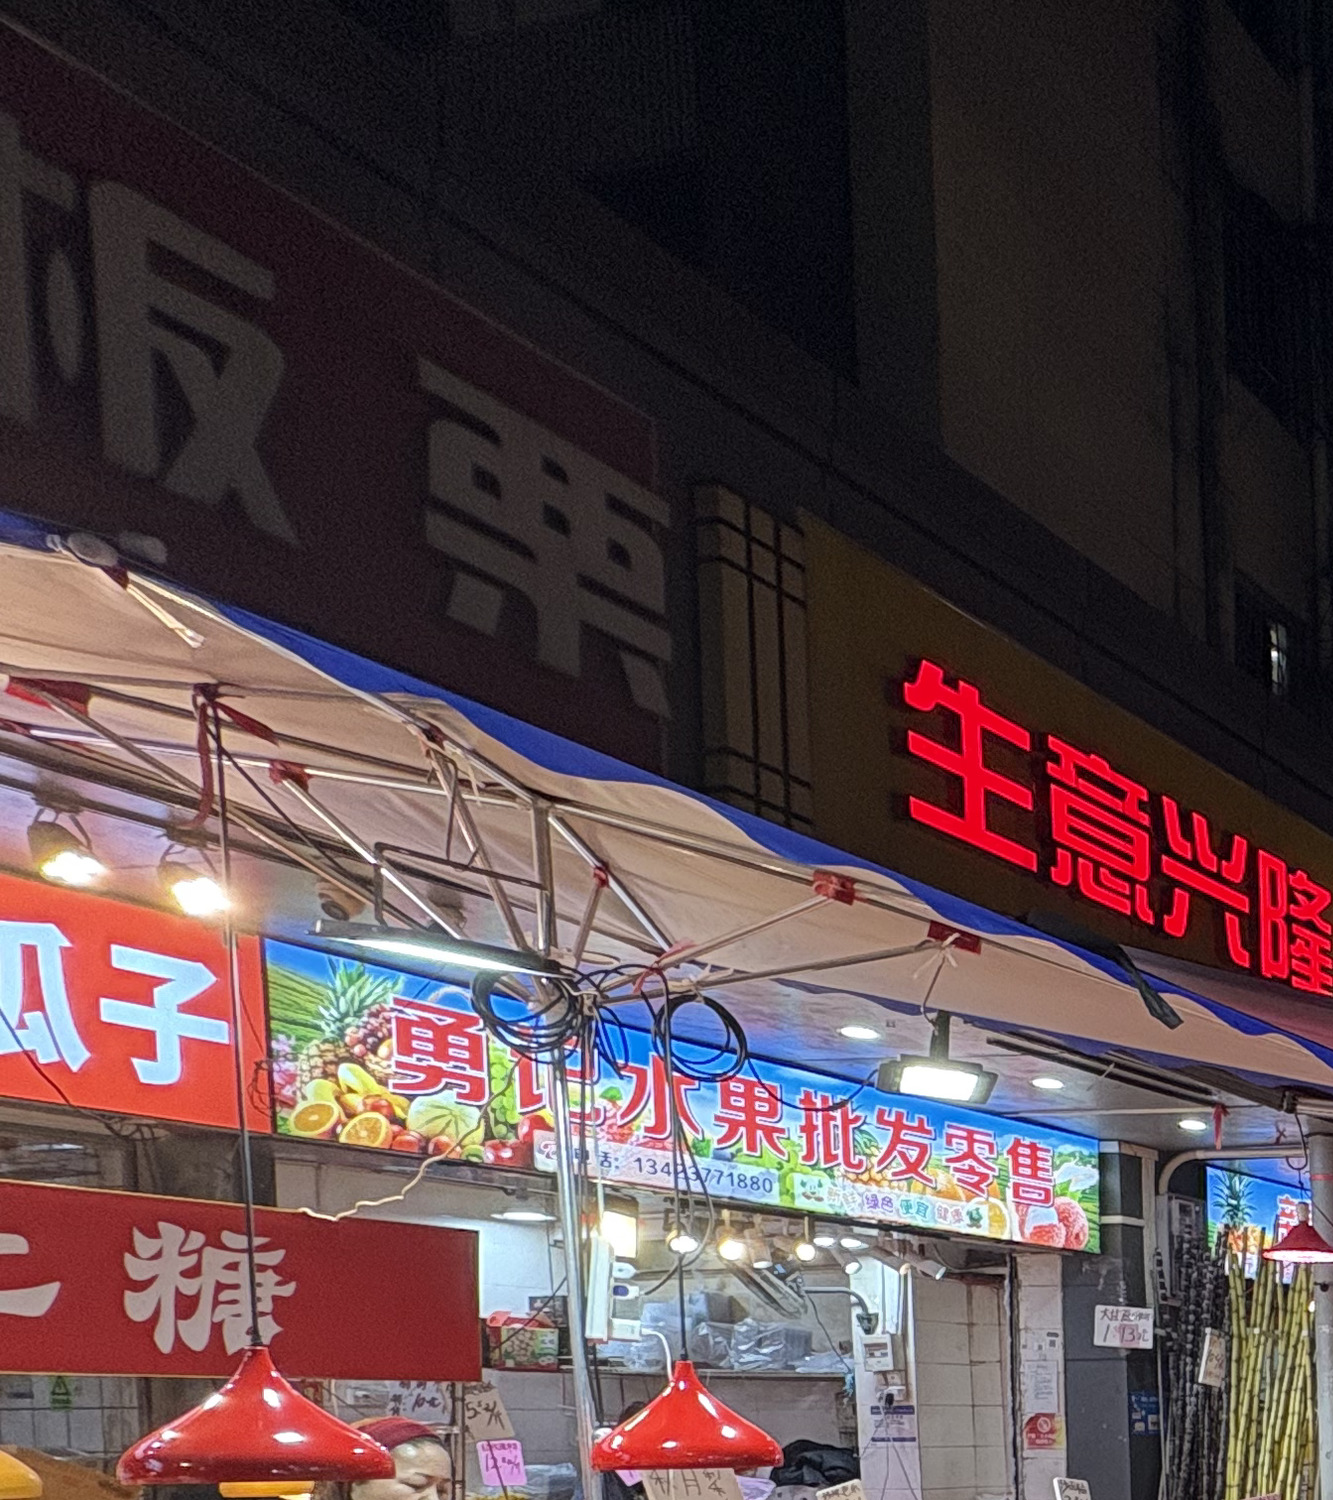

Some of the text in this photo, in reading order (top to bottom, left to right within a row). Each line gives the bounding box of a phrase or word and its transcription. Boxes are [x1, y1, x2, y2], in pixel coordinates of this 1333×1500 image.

[904, 659, 1333, 997] 生意兴隆
[0, 920, 231, 1086] 瓜子
